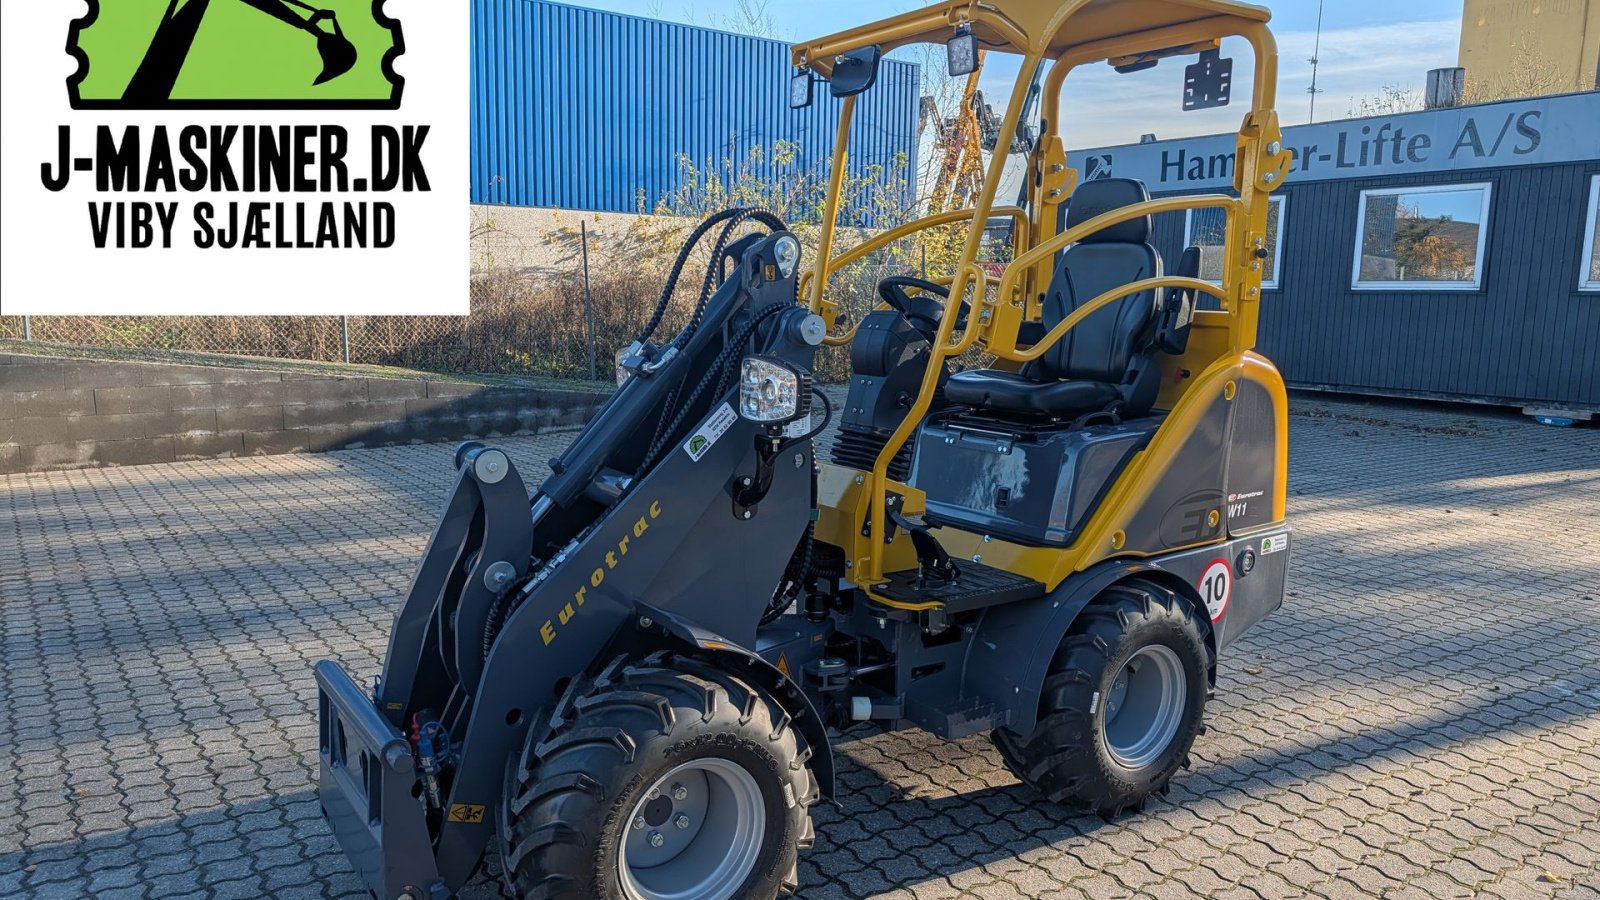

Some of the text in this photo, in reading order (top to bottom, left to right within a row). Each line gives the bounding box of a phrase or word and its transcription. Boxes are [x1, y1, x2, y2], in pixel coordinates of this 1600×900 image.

[1160, 110, 1542, 182] Hamer-Lifte A/S
[1228, 502, 1247, 518] W11
[540, 500, 661, 646] Eurotrac
[1205, 573, 1225, 604] 10
